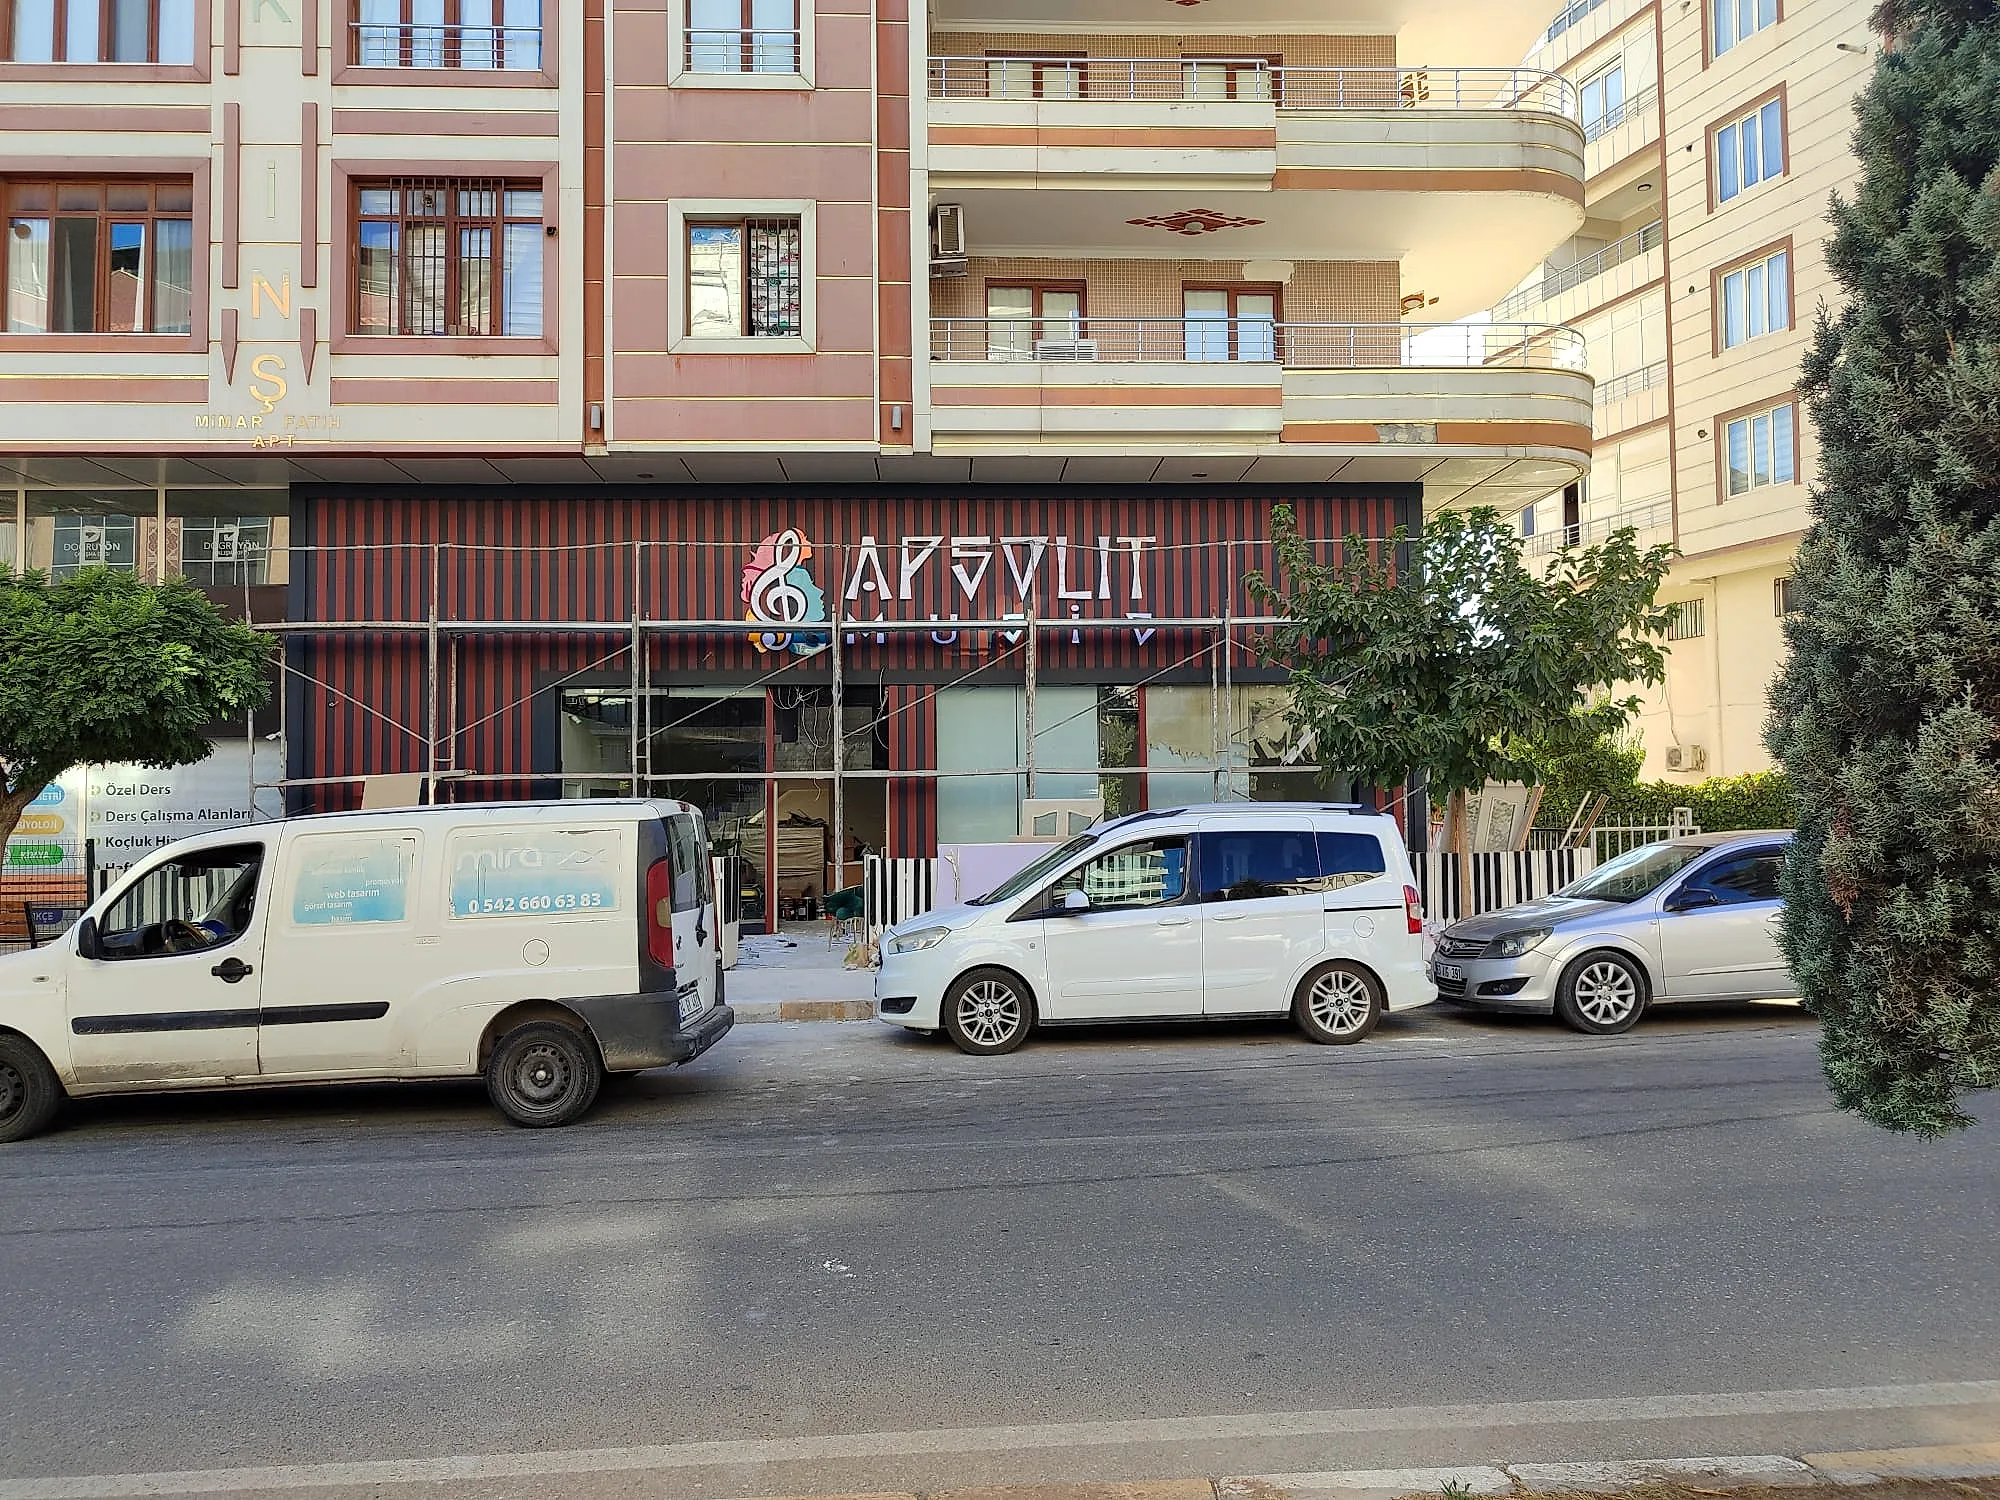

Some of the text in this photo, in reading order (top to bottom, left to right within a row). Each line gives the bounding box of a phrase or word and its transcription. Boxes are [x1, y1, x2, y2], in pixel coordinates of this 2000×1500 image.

[251, 434, 295, 448] APT
[105, 782, 171, 796] Özel Ders
[105, 808, 251, 825] Ders Çalışma Alanları
[105, 835, 153, 850] Koçluk
[327, 889, 346, 899] web
[468, 892, 601, 914] 0 542 660 63 83
